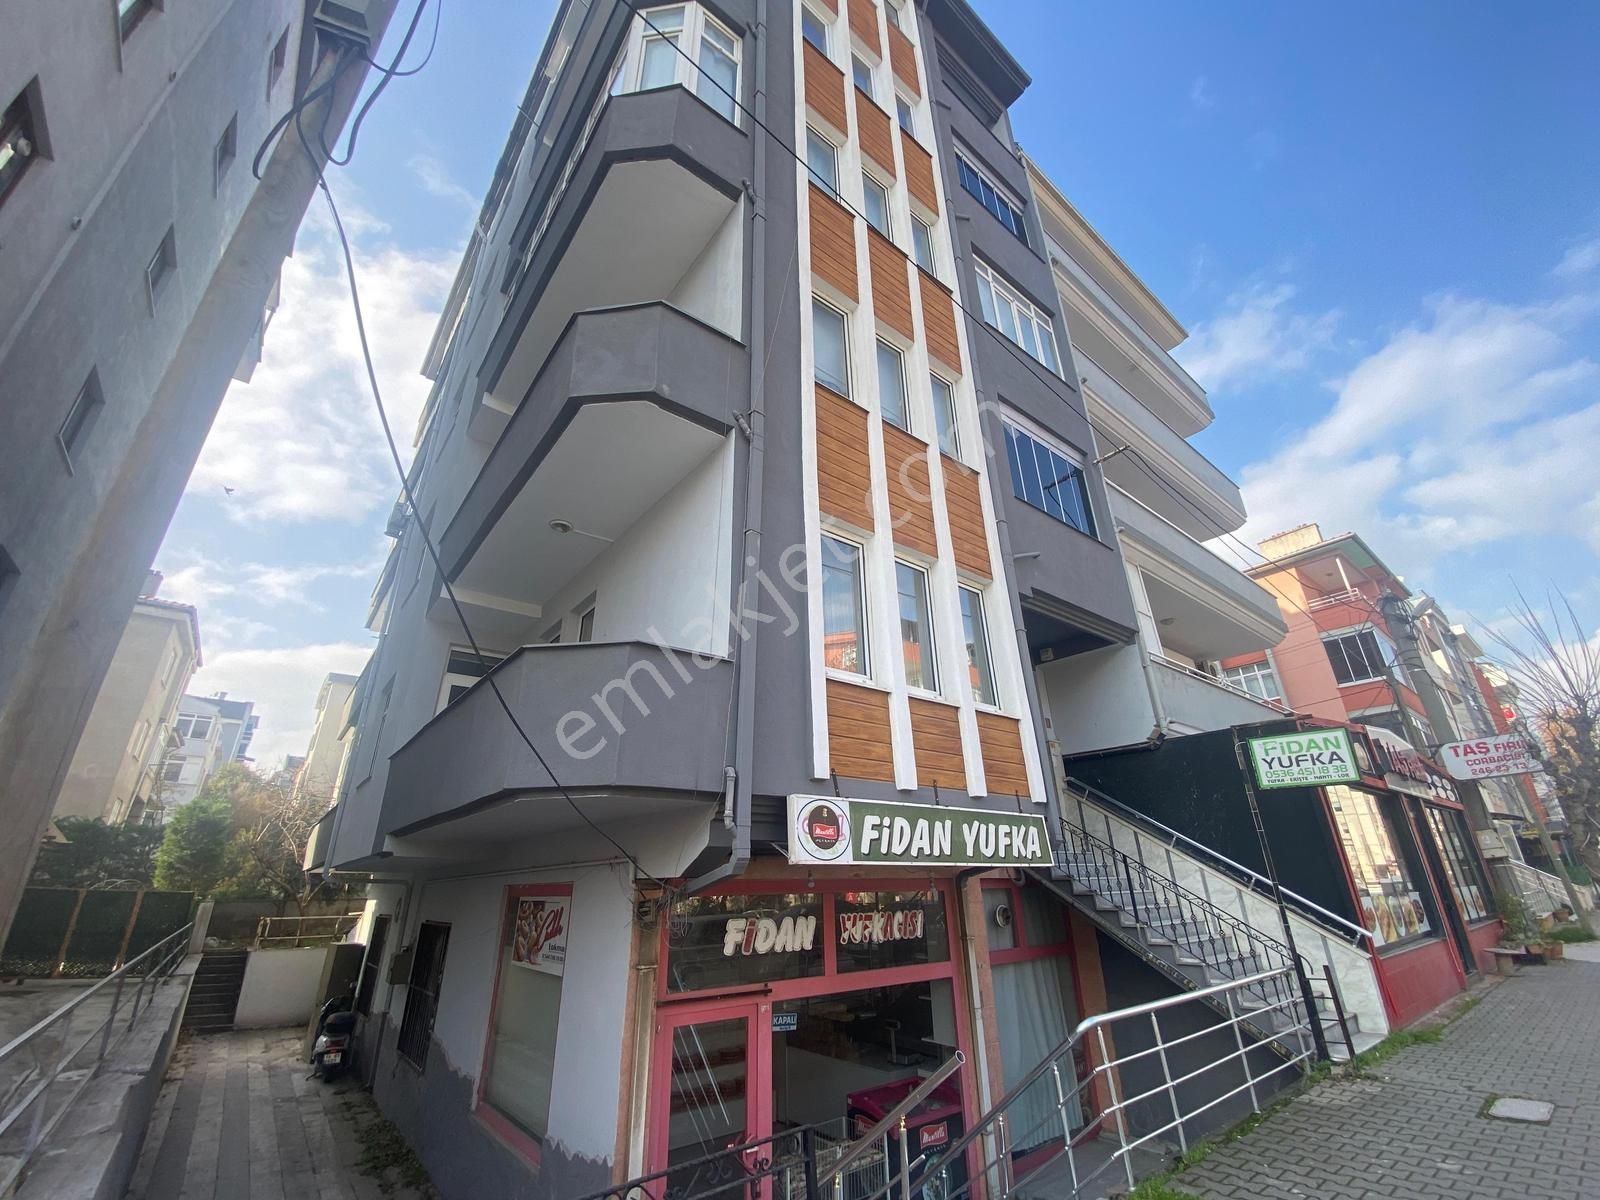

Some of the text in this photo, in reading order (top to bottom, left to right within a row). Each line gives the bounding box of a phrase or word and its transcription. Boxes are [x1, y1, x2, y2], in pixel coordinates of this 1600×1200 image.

[1448, 741, 1490, 758] TAŞ
[1261, 751, 1346, 770] YUFKA
[1265, 768, 1294, 779] 0536
[1331, 764, 1348, 774] 38
[963, 820, 1042, 859] YUFKA
